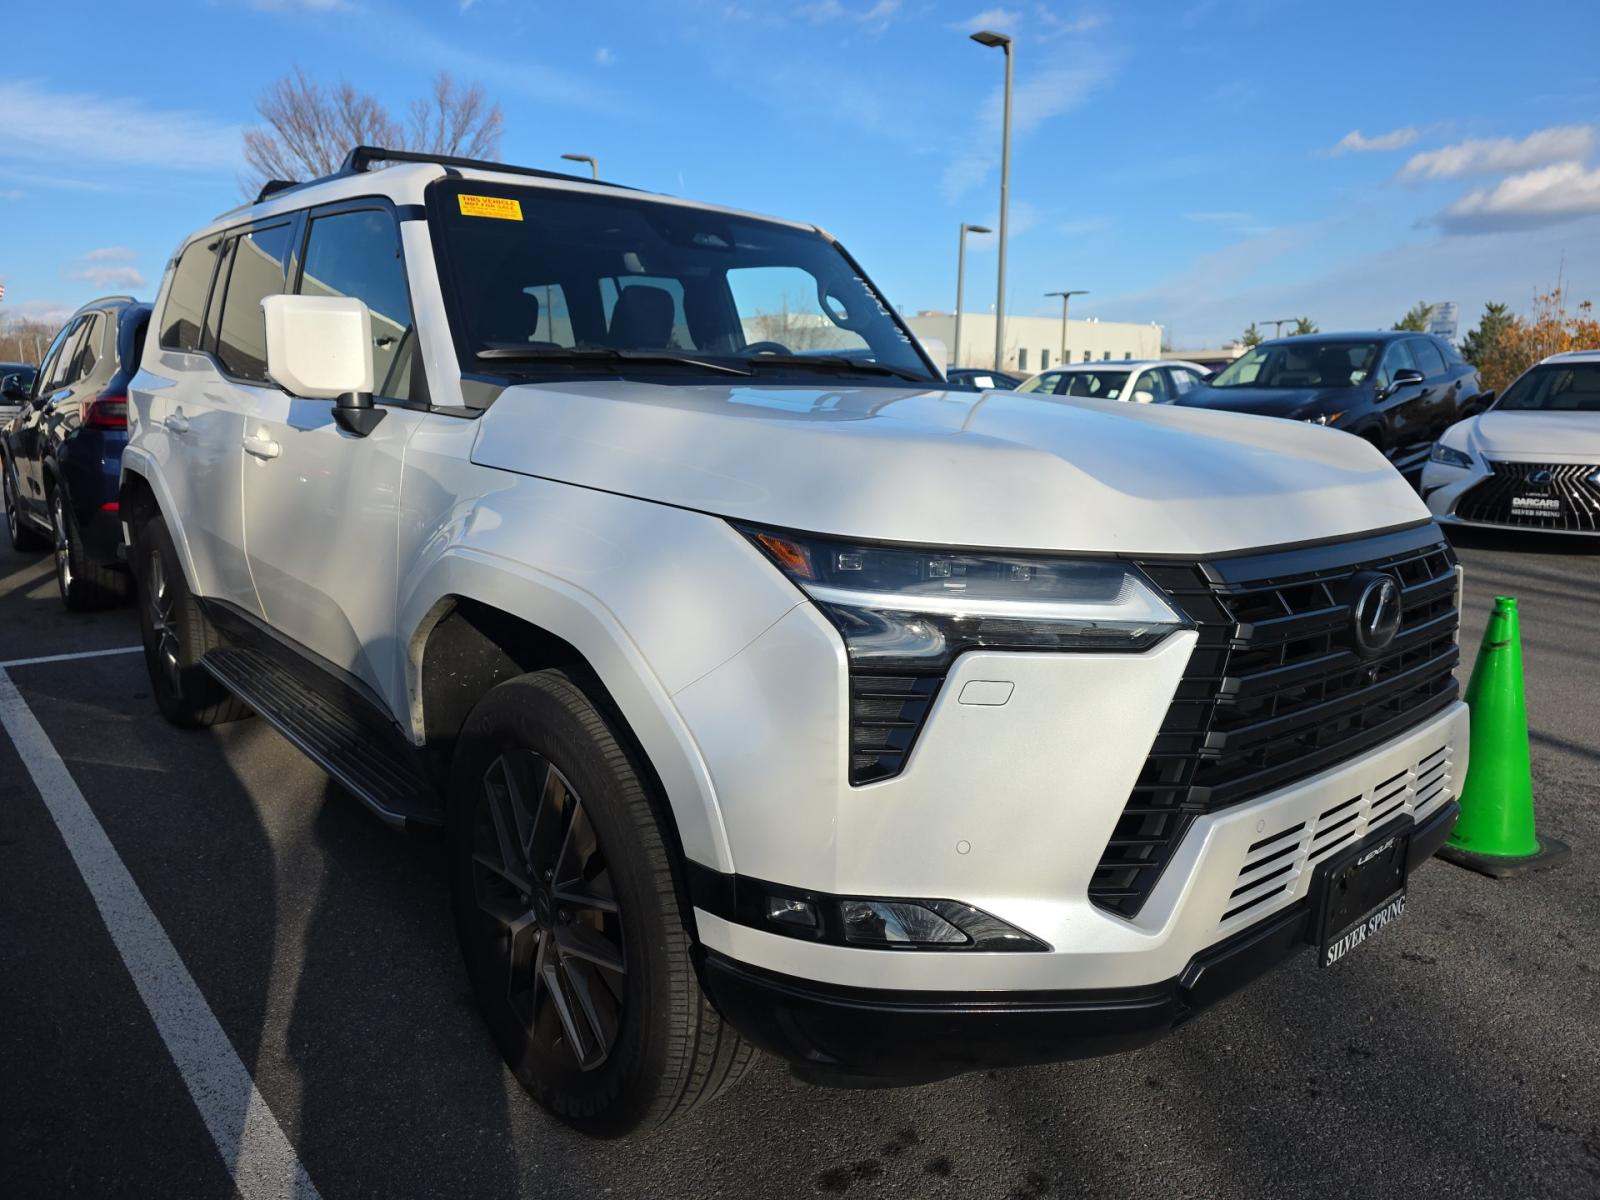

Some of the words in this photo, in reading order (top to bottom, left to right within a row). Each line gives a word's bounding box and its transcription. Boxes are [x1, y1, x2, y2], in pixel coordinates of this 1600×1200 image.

[1512, 497, 1560, 508] DARCARS
[1326, 923, 1367, 967] SILVER
[1368, 895, 1406, 937] SPRING
